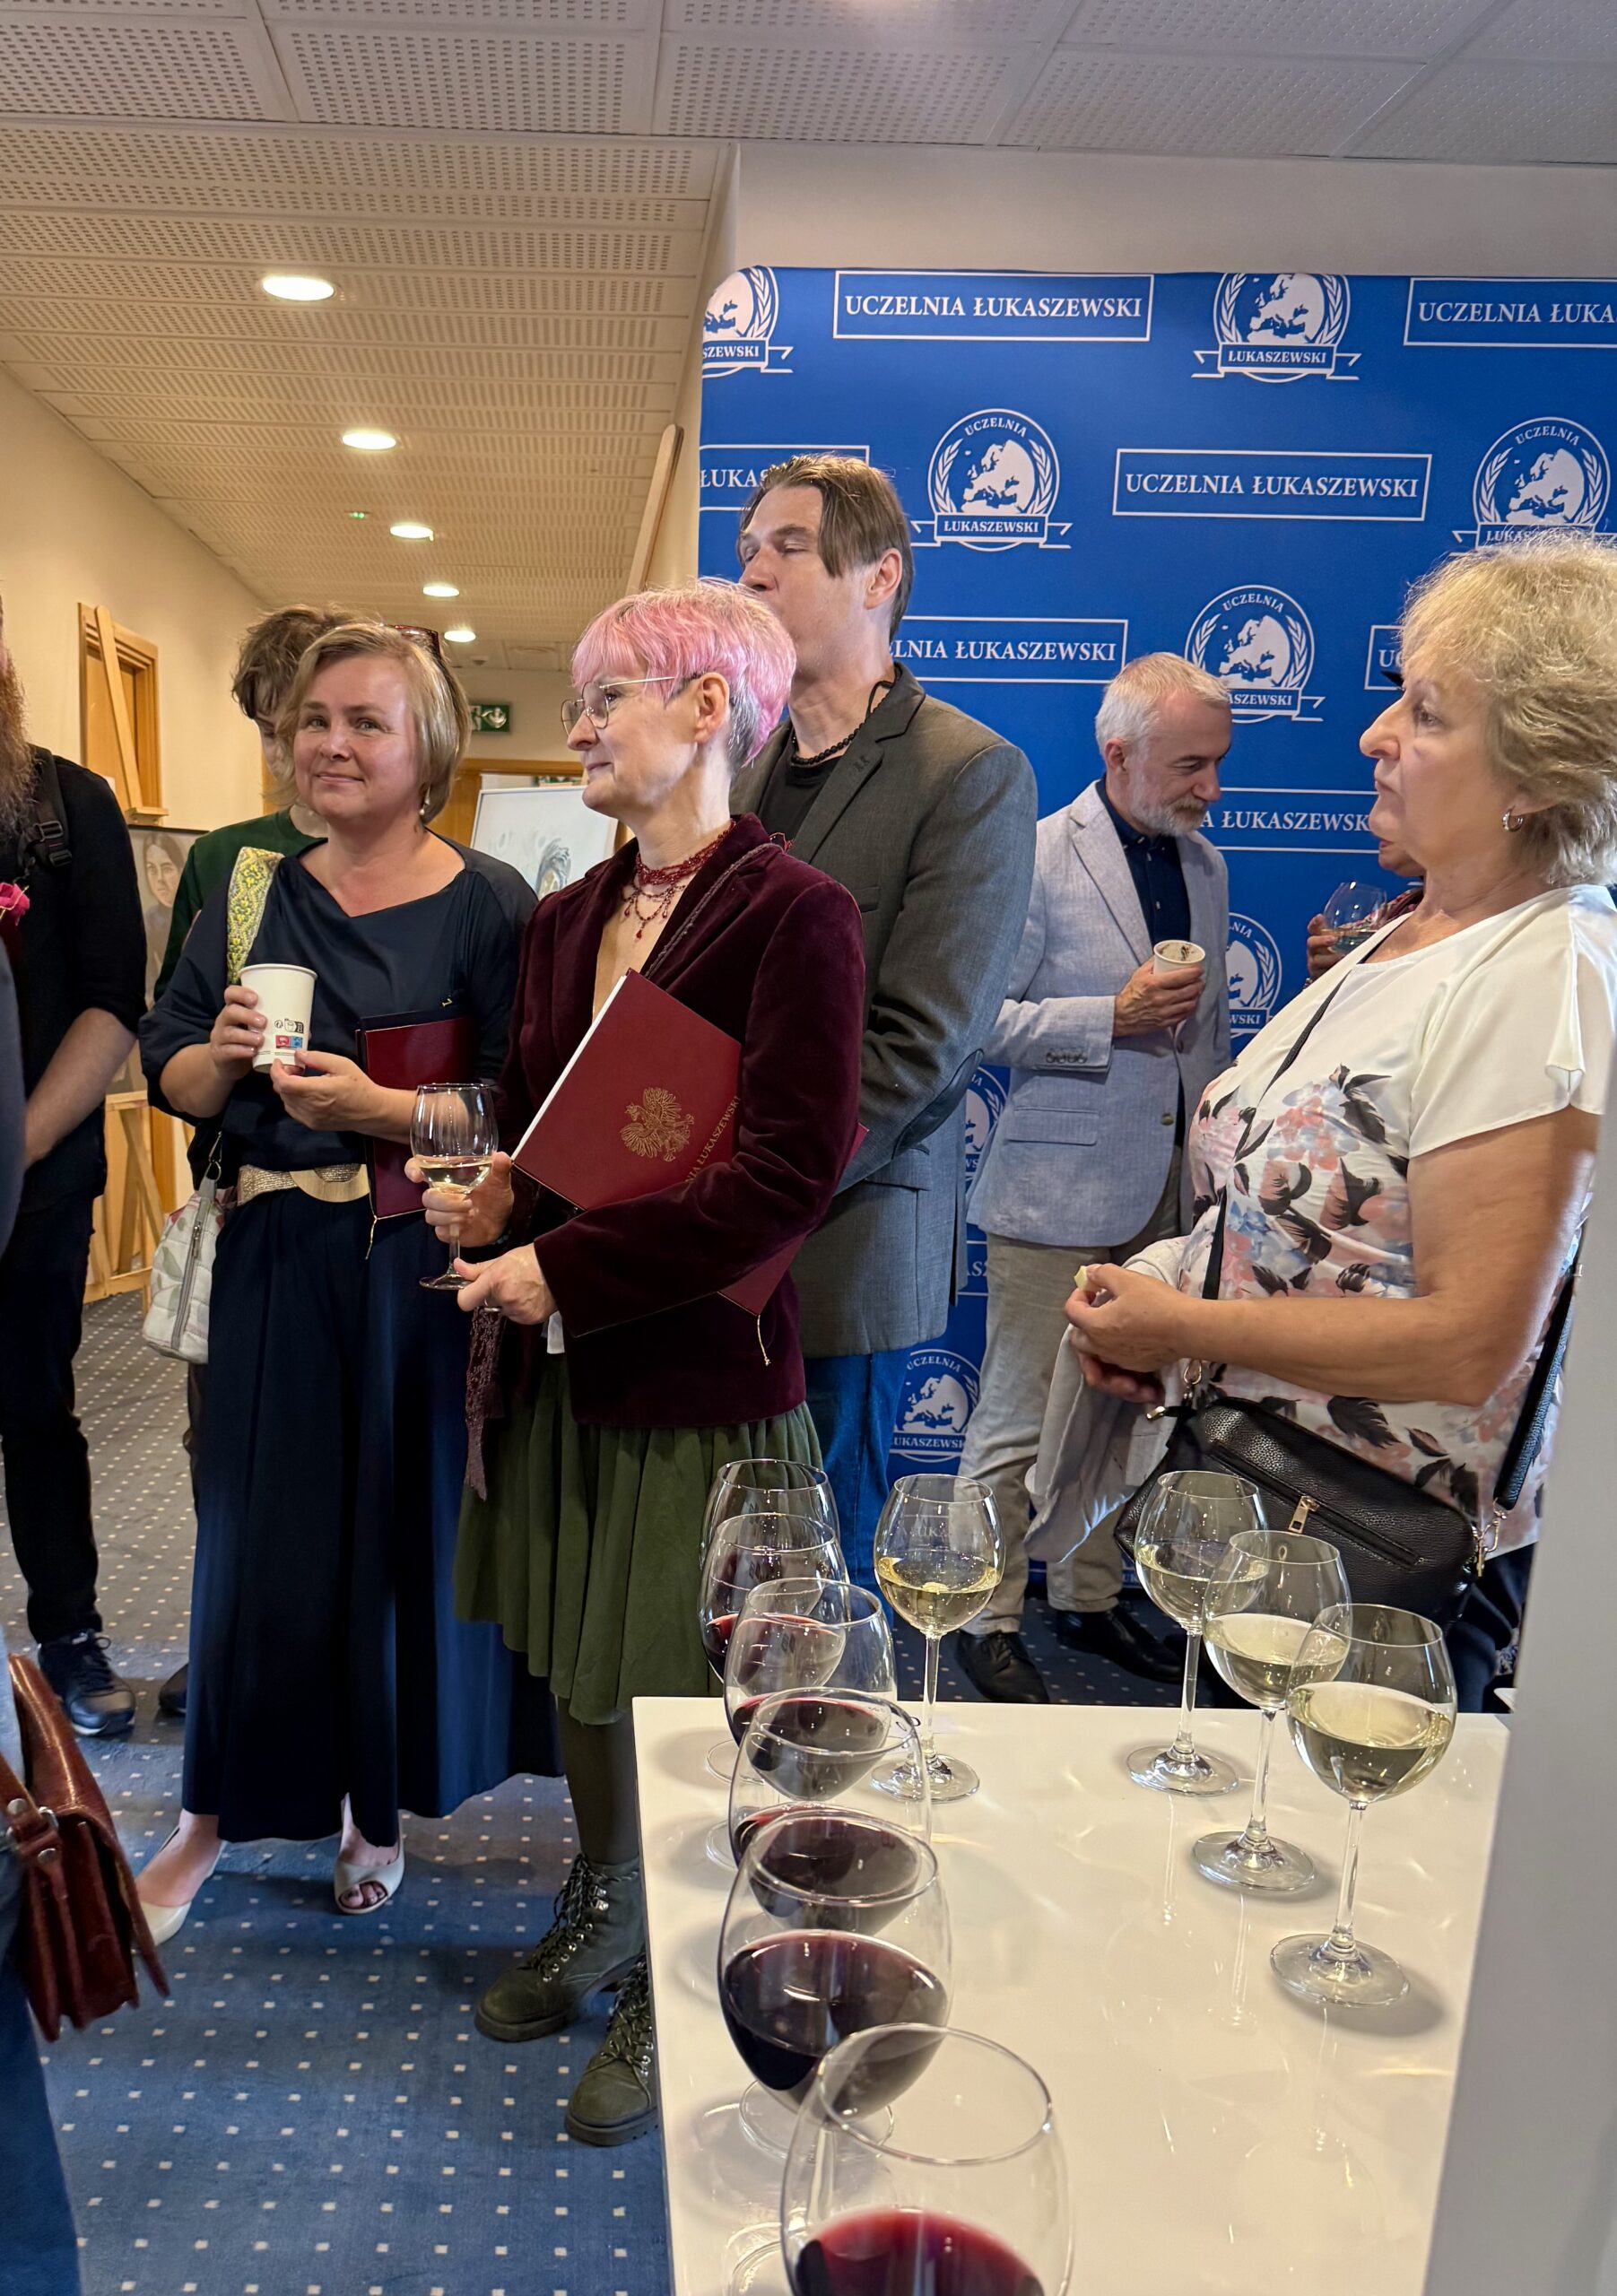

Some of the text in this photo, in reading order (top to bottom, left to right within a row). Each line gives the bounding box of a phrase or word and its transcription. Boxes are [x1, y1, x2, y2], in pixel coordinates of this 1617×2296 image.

[845, 295, 1143, 317] UCZELNIA ŁUKASZEWSKI
[1418, 302, 1617, 323] UCZELNIA ŁUKA
[1228, 350, 1326, 363] ŁUKASZEWSKI
[964, 417, 1027, 438] UCZELNIA
[1515, 425, 1580, 446] UCZELNIA
[1126, 474, 1419, 498] UCZELNIA ŁUKASZEWSKI
[943, 520, 1039, 533] ŁUKASZEWSKI
[1222, 593, 1284, 613] UCZELNIA
[955, 641, 1117, 661] ŁUKASZEWSKI
[1221, 811, 1371, 831] ŁUKASZEWSK
[906, 1356, 961, 1372] UCZELNIA
